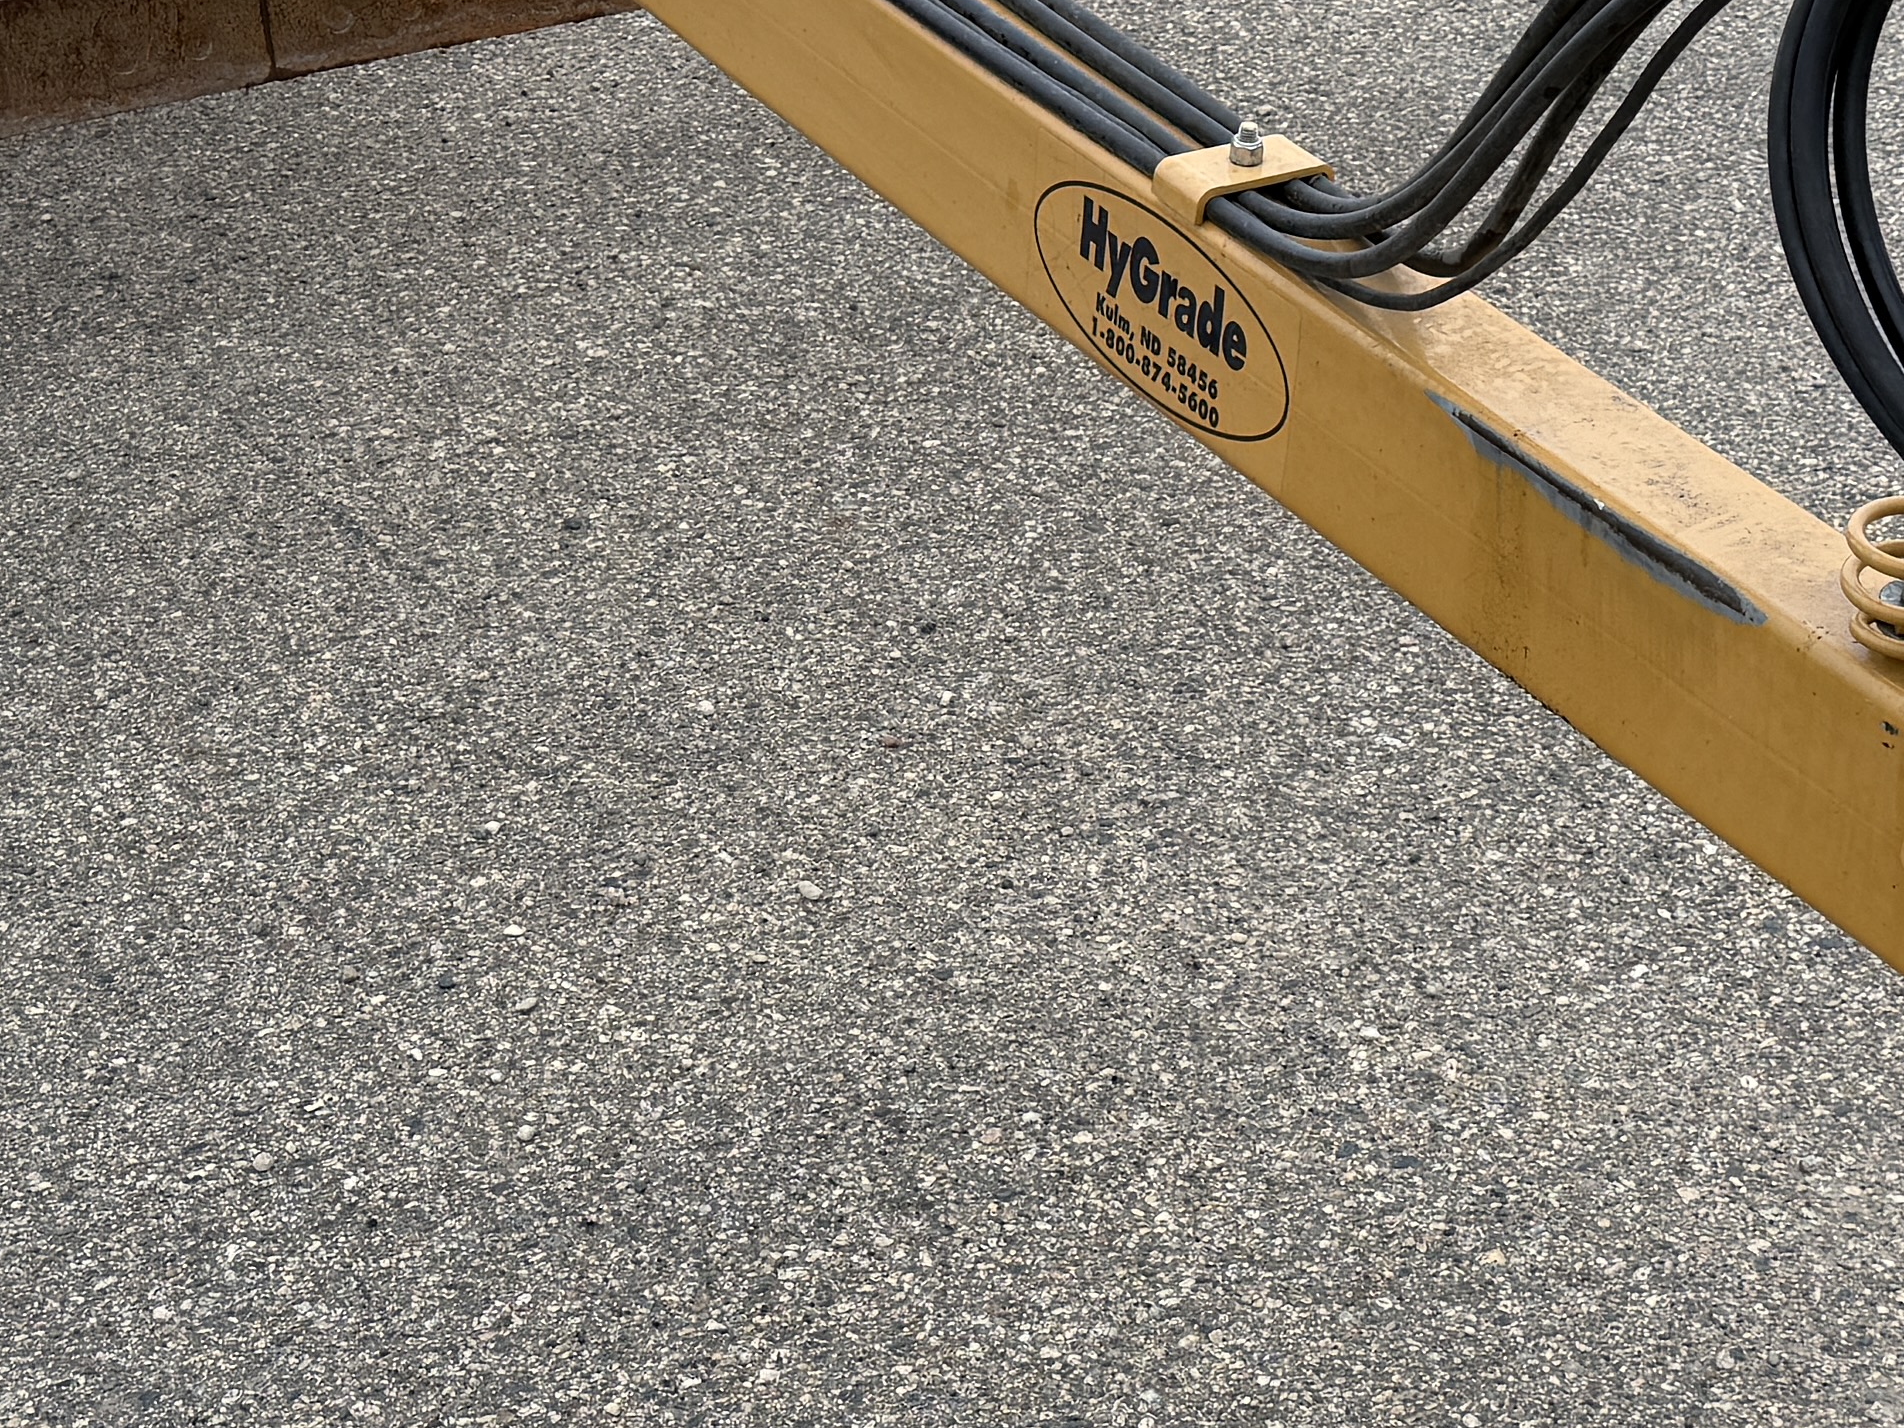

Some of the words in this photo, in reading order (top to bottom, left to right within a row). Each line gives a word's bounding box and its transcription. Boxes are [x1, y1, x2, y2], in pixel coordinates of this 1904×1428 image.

[1079, 194, 1247, 372] HyGrade
[1091, 315, 1220, 429] 1-800-874-5600
[1095, 291, 1135, 343] Kulm,
[1139, 324, 1162, 357] ND
[1166, 346, 1219, 401] 58456
